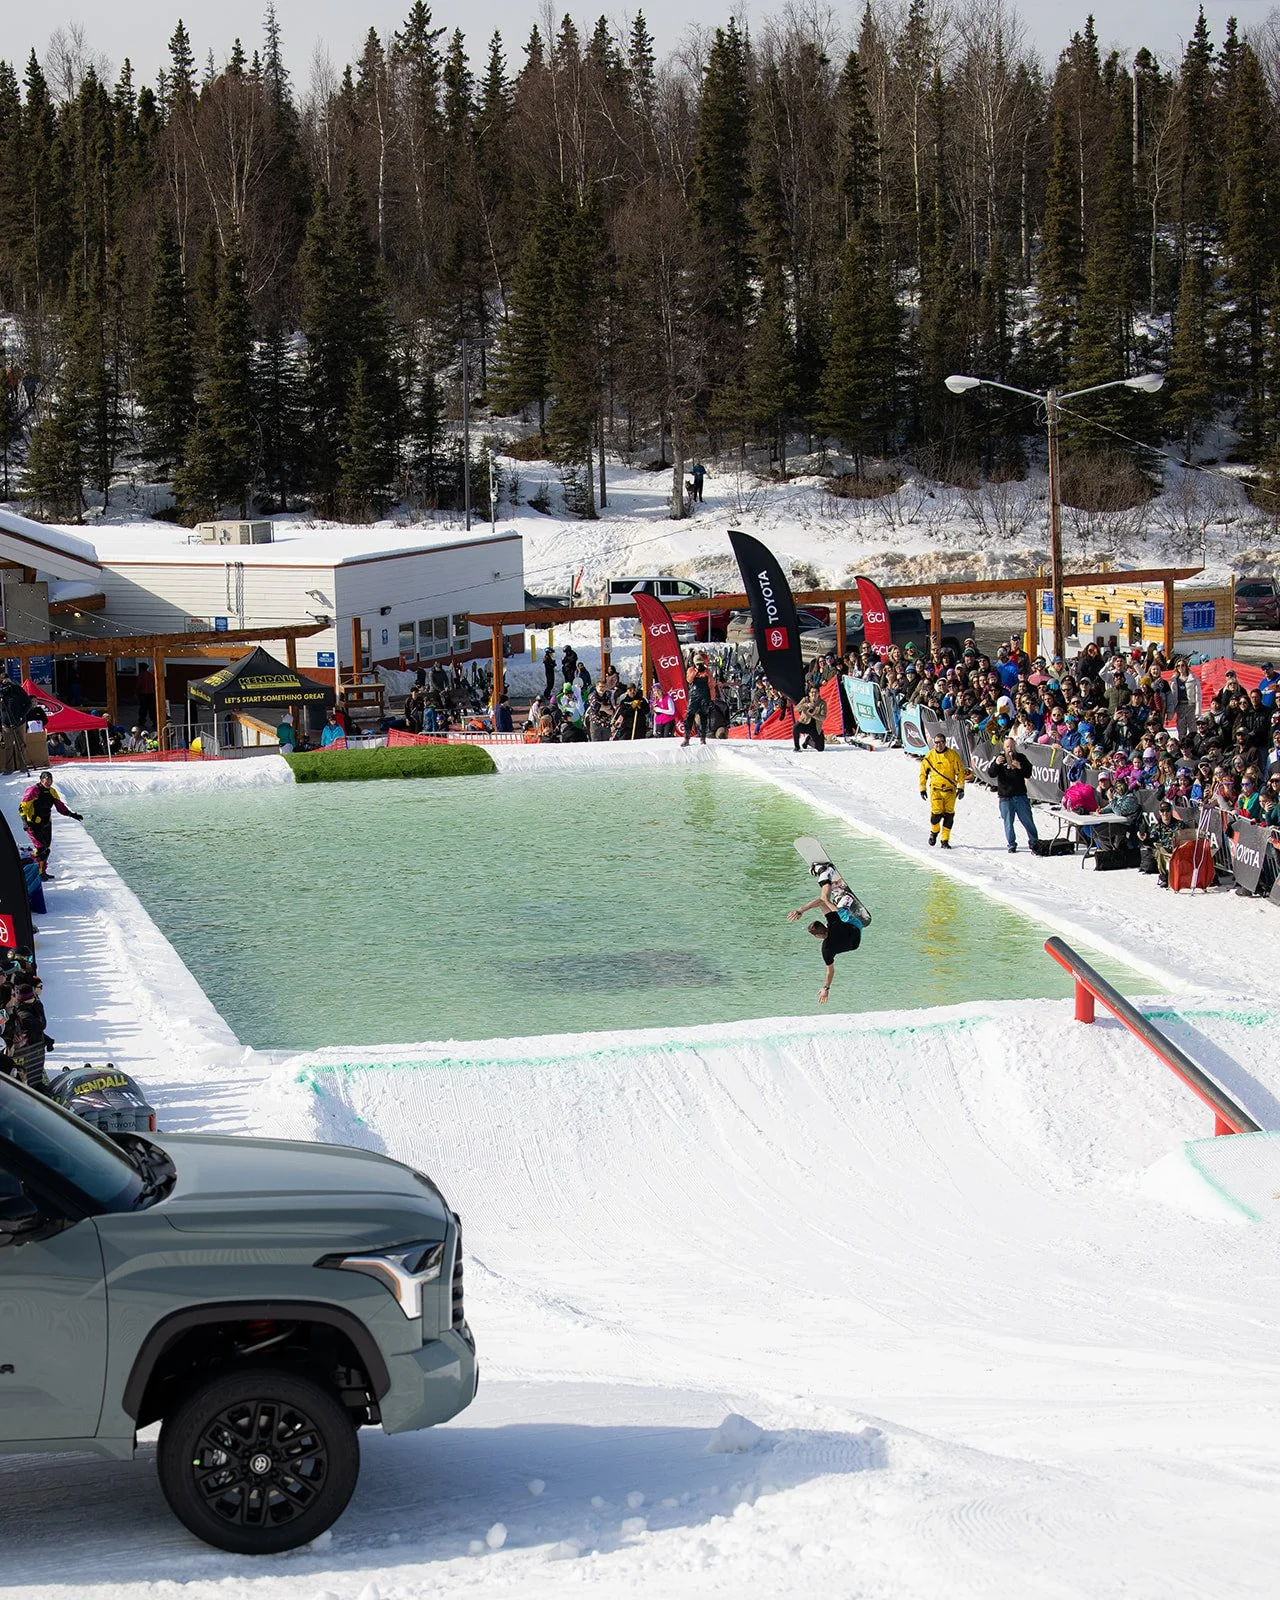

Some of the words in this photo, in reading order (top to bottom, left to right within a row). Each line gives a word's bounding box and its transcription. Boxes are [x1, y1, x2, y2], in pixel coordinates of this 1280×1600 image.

[757, 570, 779, 624] TOYOTA
[867, 612, 886, 624] GCI
[650, 623, 671, 637] GCI
[660, 656, 679, 669] GCI
[239, 674, 300, 686] KENDALL
[224, 695, 241, 704] LET'S
[242, 694, 261, 703] START
[262, 693, 302, 702] SOMETHING
[303, 692, 325, 700] GREAT
[1030, 764, 1060, 783] OYOTA
[74, 1075, 128, 1095] KENDALL
